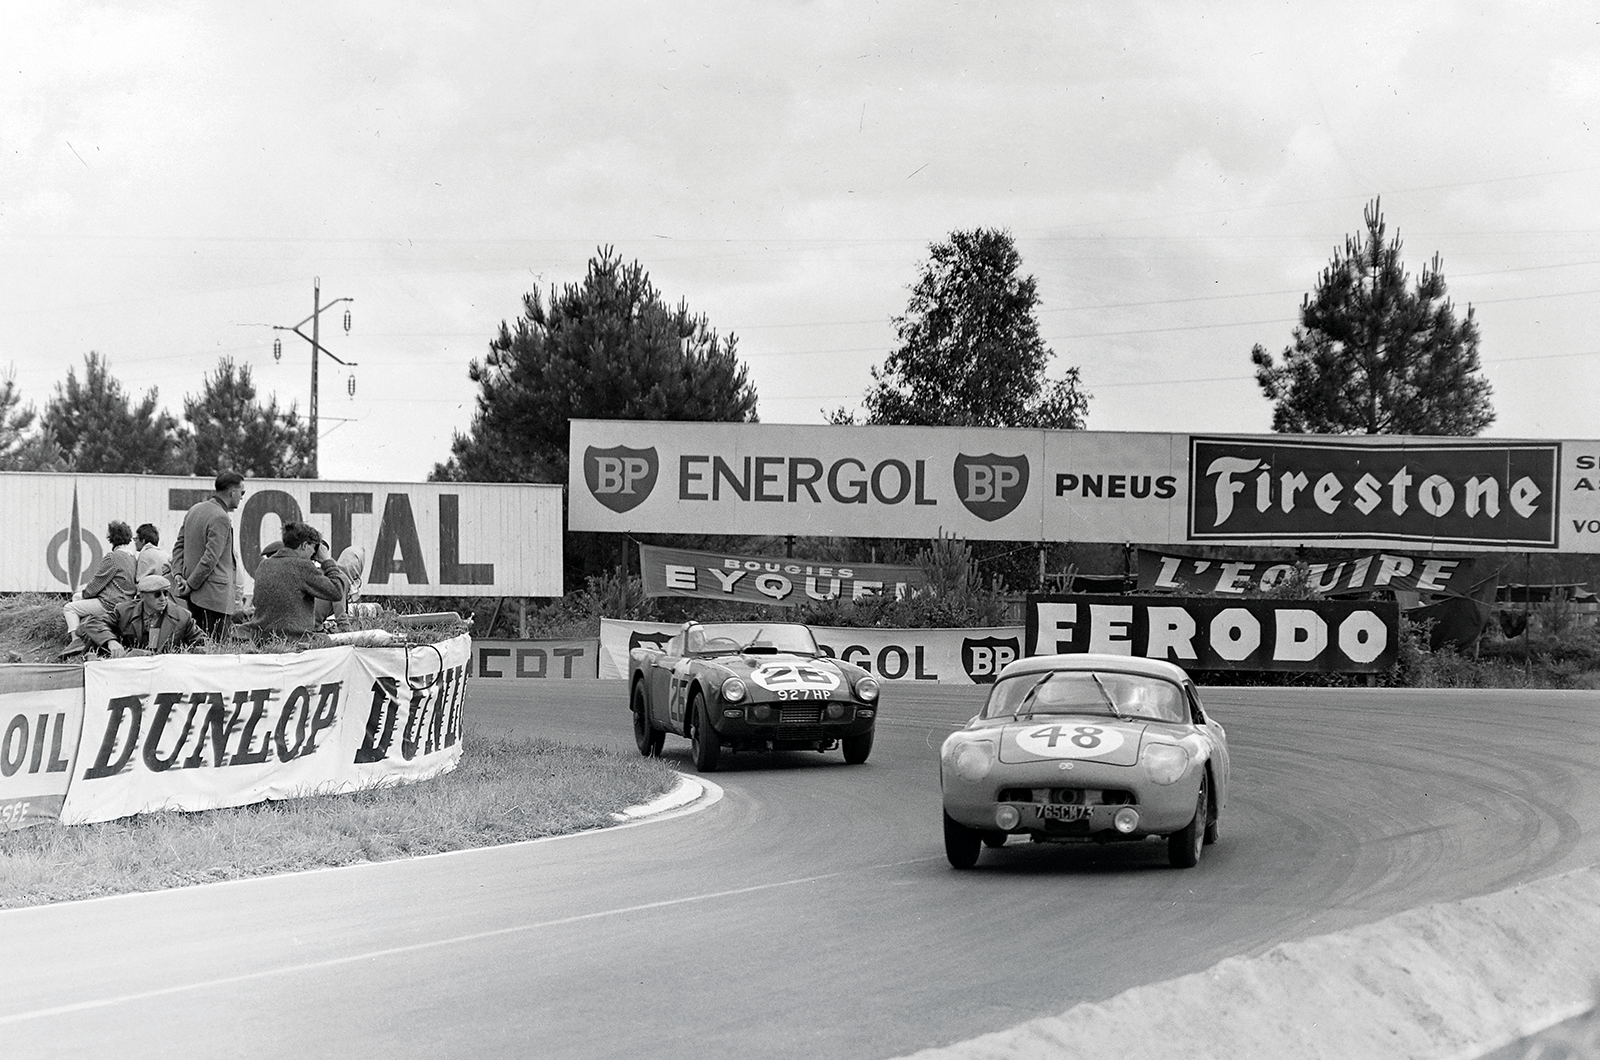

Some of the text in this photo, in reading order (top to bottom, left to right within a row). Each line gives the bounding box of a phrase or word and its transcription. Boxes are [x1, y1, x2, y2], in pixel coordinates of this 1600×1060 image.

[594, 455, 1020, 505] BP ENERGOL BP
[1576, 455, 1600, 470] S
[1055, 455, 1542, 528] PNEUS Firestone
[1573, 477, 1600, 491] A
[724, 558, 854, 578] BOUGIES
[1154, 553, 1460, 594] L'EQUIPE
[1033, 602, 1388, 663] FERODO
[760, 666, 832, 685] 26
[1, 713, 69, 778] OIL
[82, 680, 344, 781] DUNLOP
[1029, 725, 1104, 749] 48
